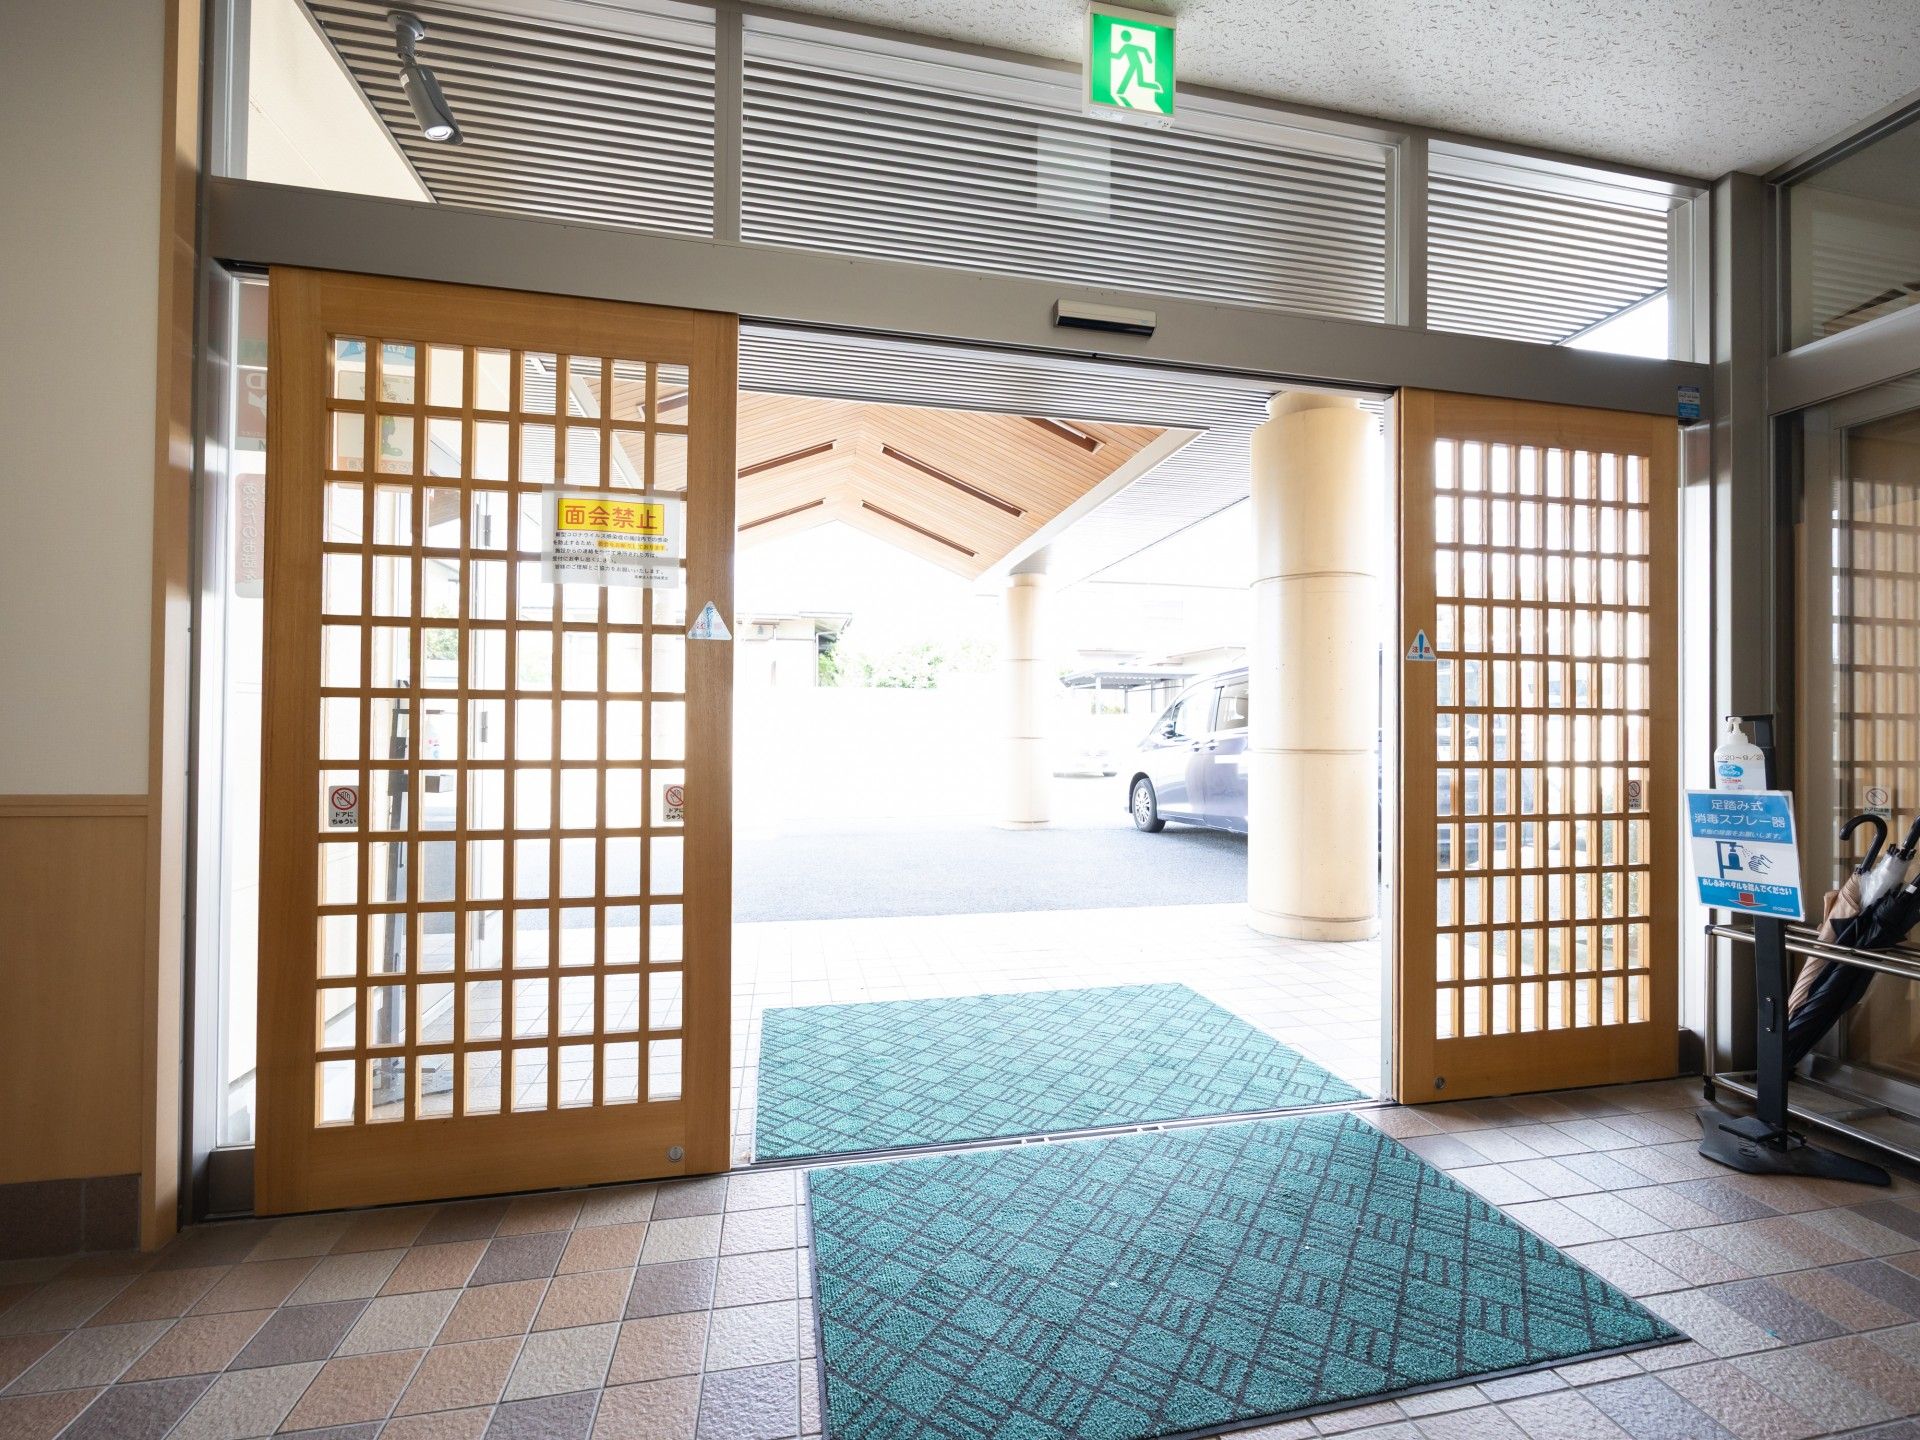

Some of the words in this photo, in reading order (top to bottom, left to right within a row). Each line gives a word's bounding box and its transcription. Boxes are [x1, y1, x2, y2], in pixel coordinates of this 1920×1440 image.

[565, 505, 657, 529] 面会禁止
[1711, 800, 1763, 811] 足踏み式
[1695, 812, 1785, 828] 消毒スプレー器
